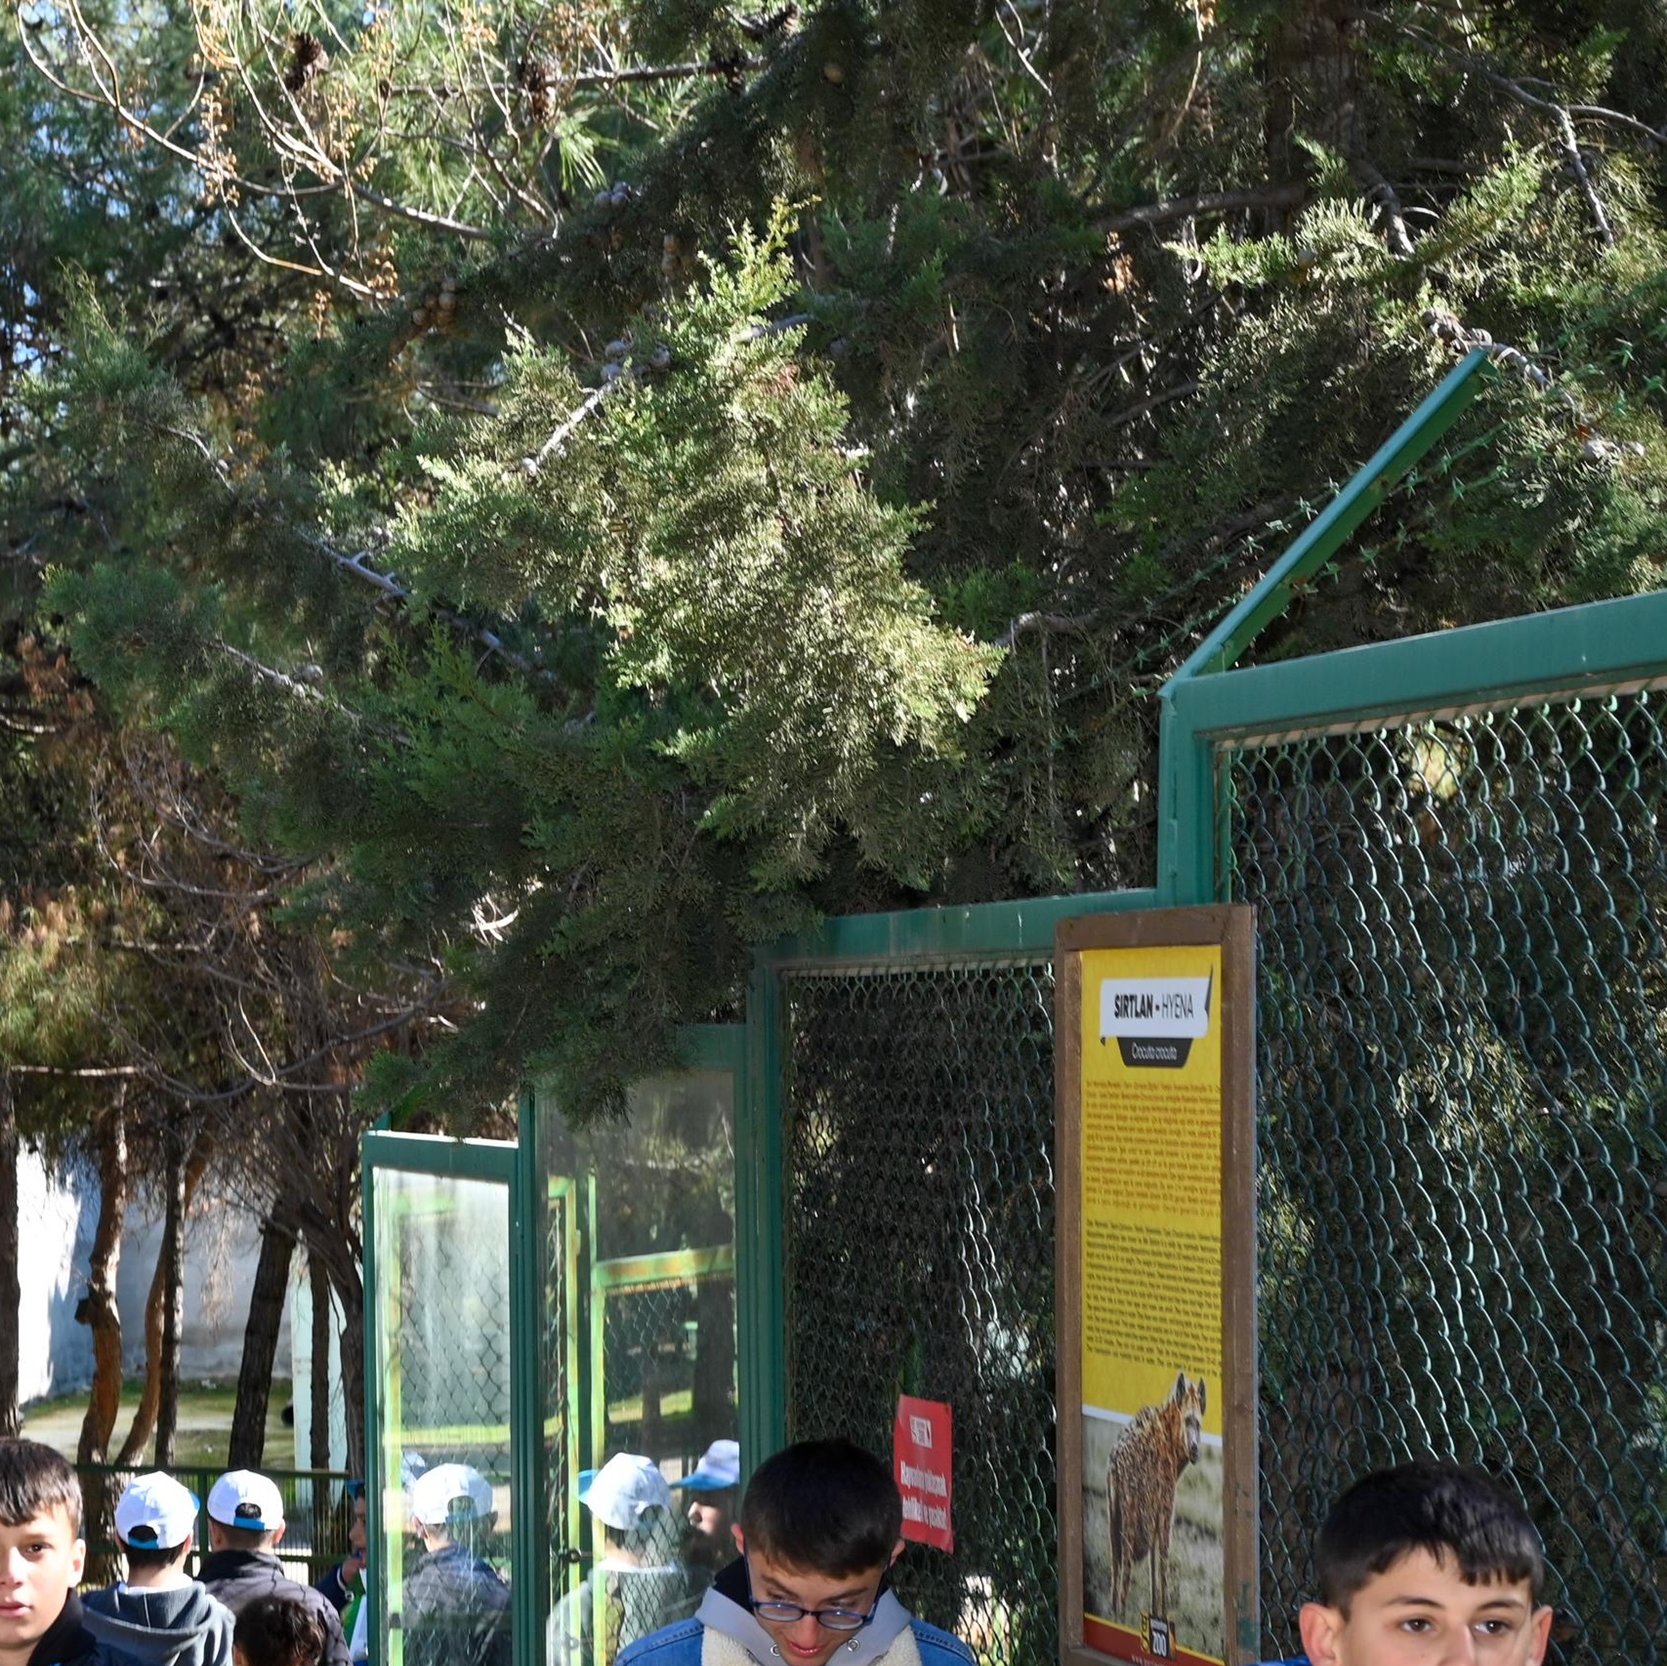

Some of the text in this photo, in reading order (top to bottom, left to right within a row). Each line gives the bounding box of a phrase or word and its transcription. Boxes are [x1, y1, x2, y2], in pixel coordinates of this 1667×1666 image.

[1114, 994, 1153, 1019] SIRTLAN
[1162, 994, 1194, 1019] HYENA
[1152, 1630, 1167, 1657] ZOO
